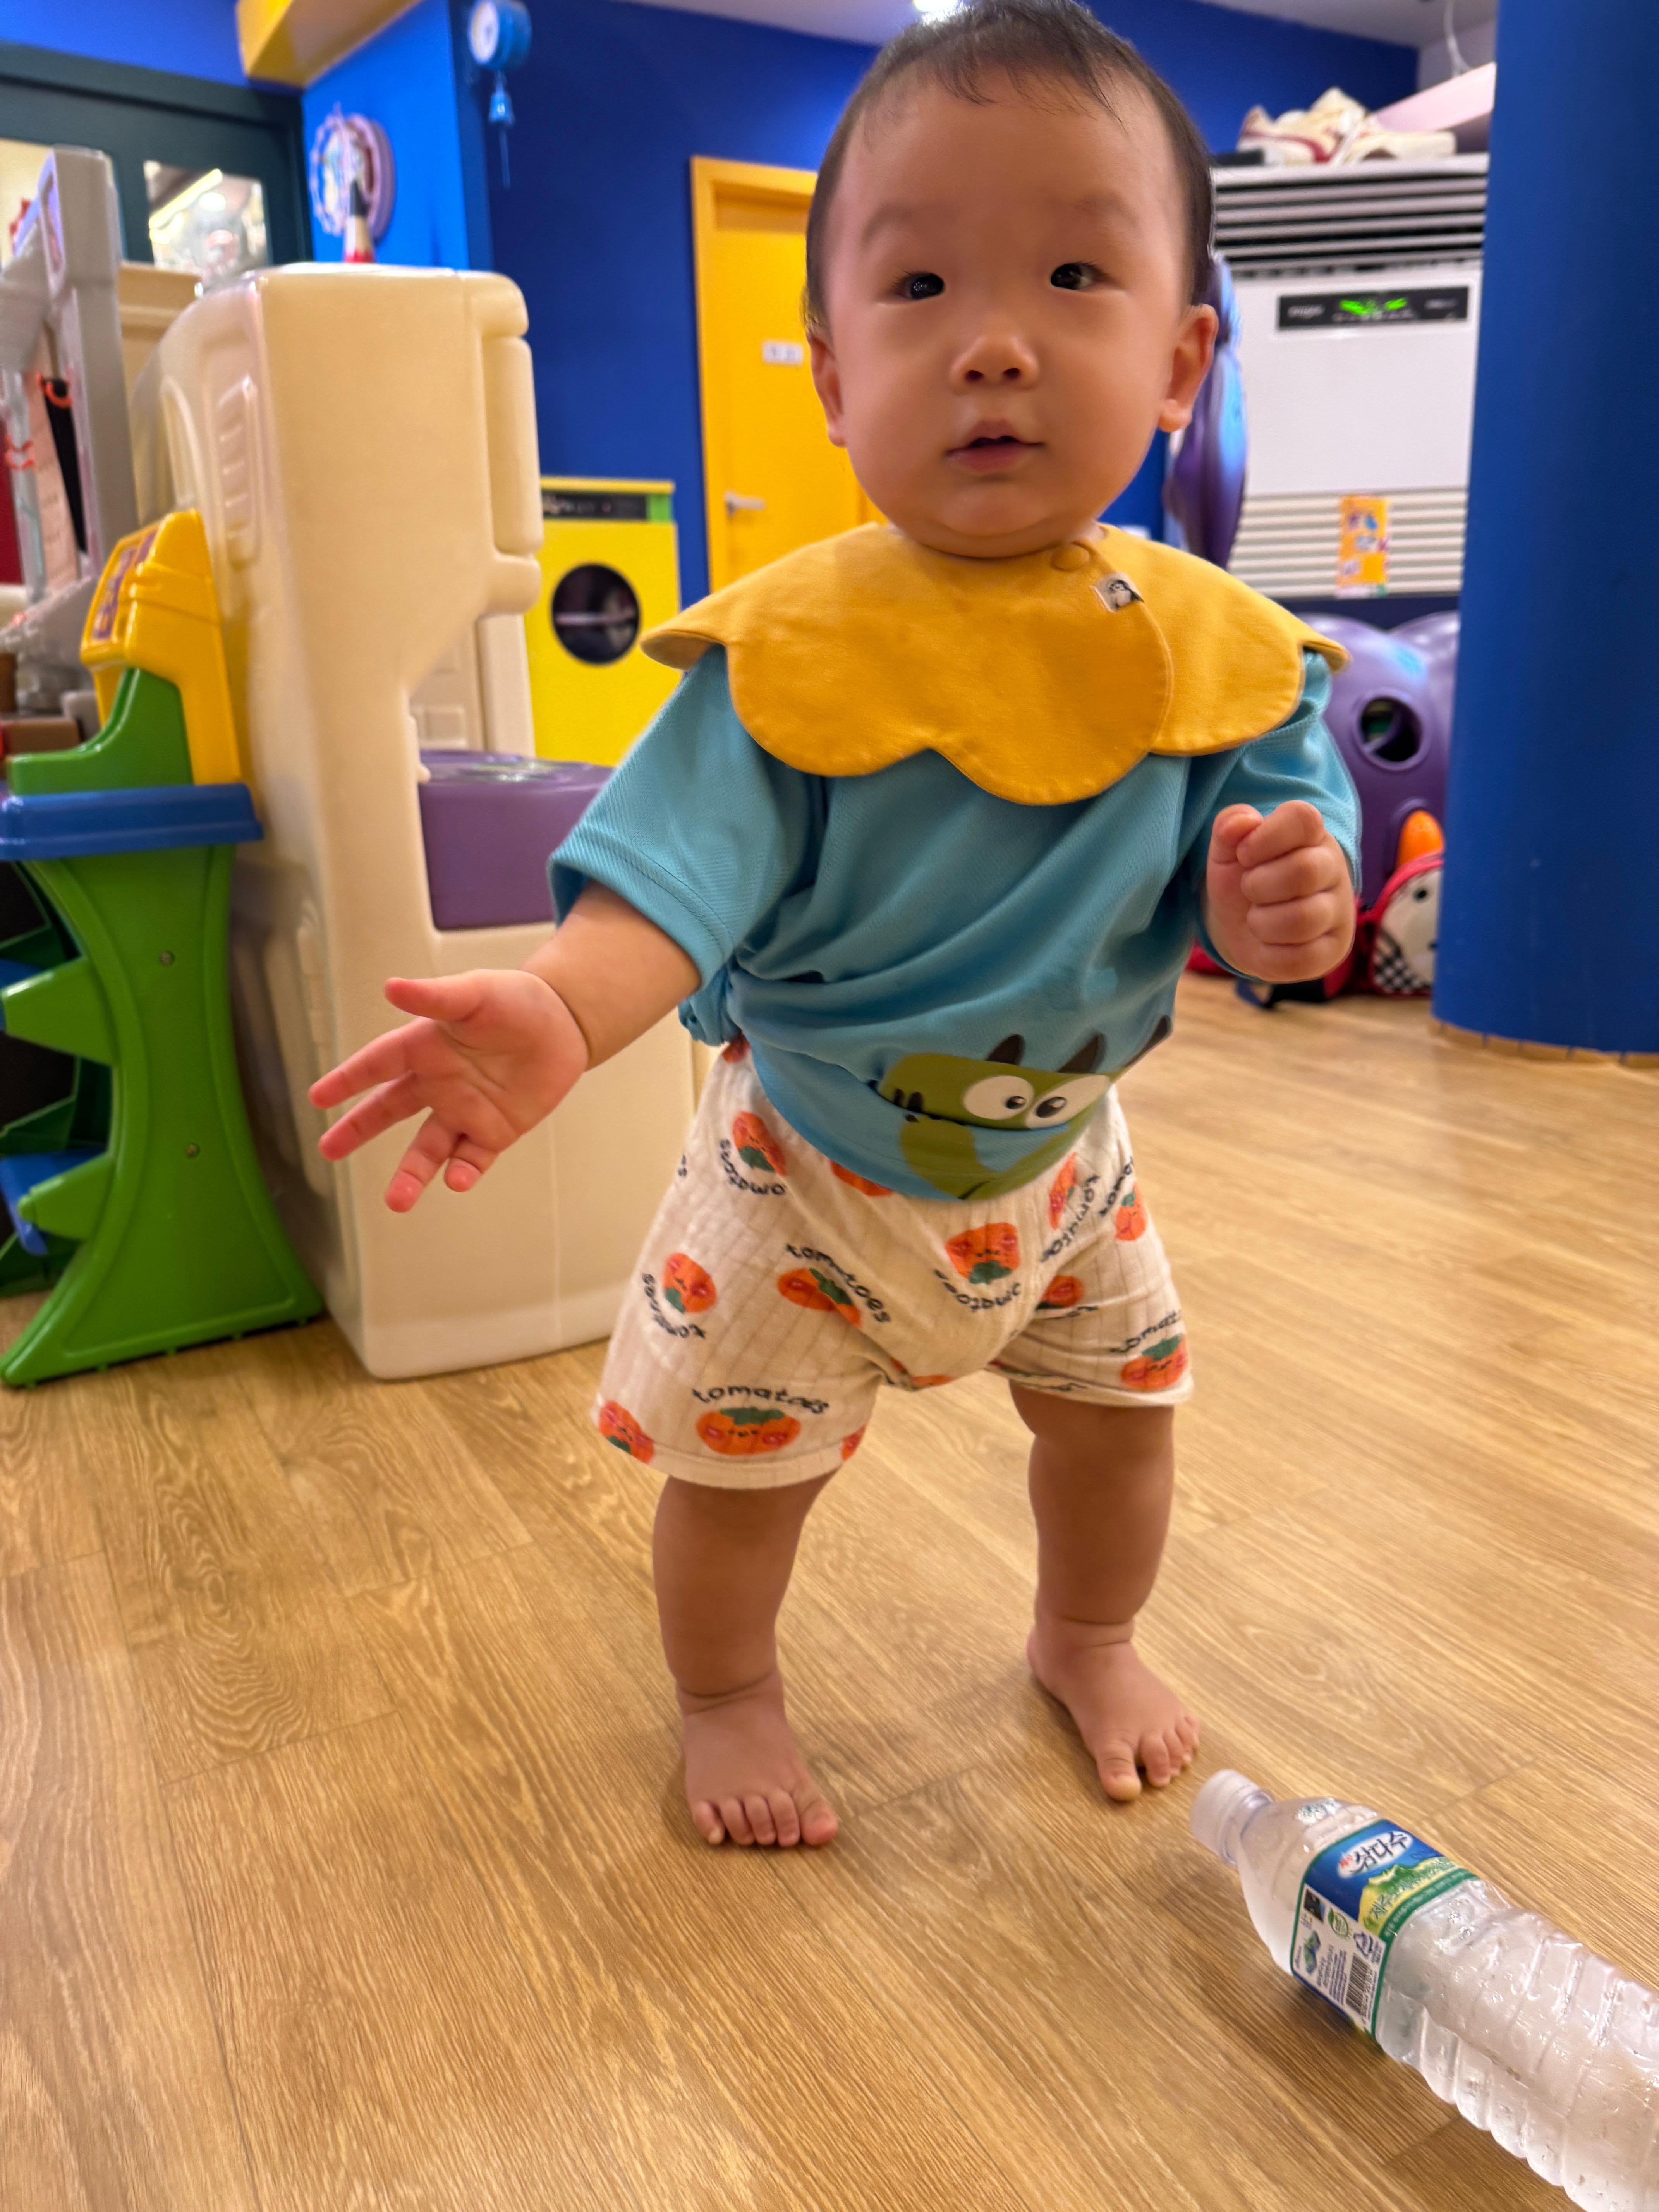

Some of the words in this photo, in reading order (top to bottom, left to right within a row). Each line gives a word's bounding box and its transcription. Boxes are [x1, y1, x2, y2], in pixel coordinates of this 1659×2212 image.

[719, 1138, 785, 1195] omatoes
[785, 1242, 890, 1323] tomtoes
[1350, 1831, 1407, 1874] 삼다수
